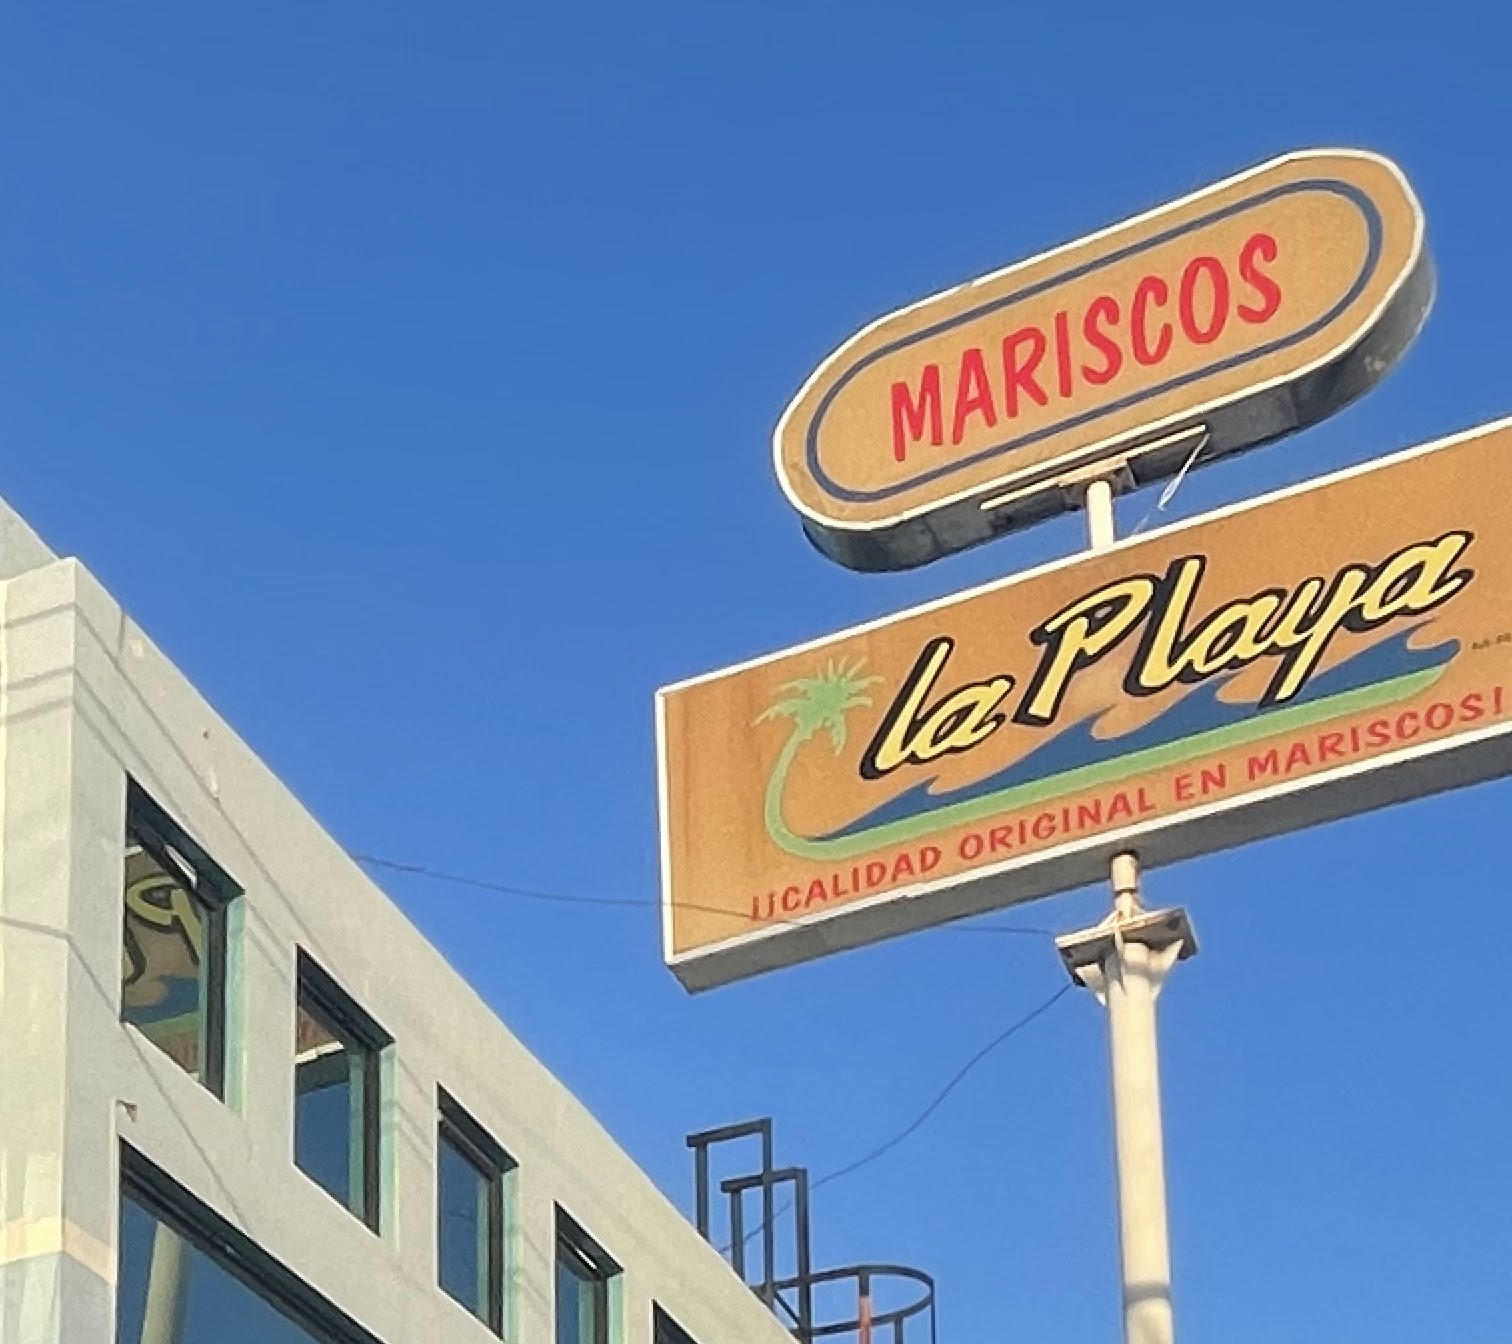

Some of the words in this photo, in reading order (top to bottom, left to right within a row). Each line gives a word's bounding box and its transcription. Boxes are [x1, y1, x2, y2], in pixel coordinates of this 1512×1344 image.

[890, 233, 1283, 462] MARISCOS
[1012, 530, 1474, 725] Playa
[958, 787, 1157, 860] ORIGINAL
[1174, 762, 1227, 801] EN
